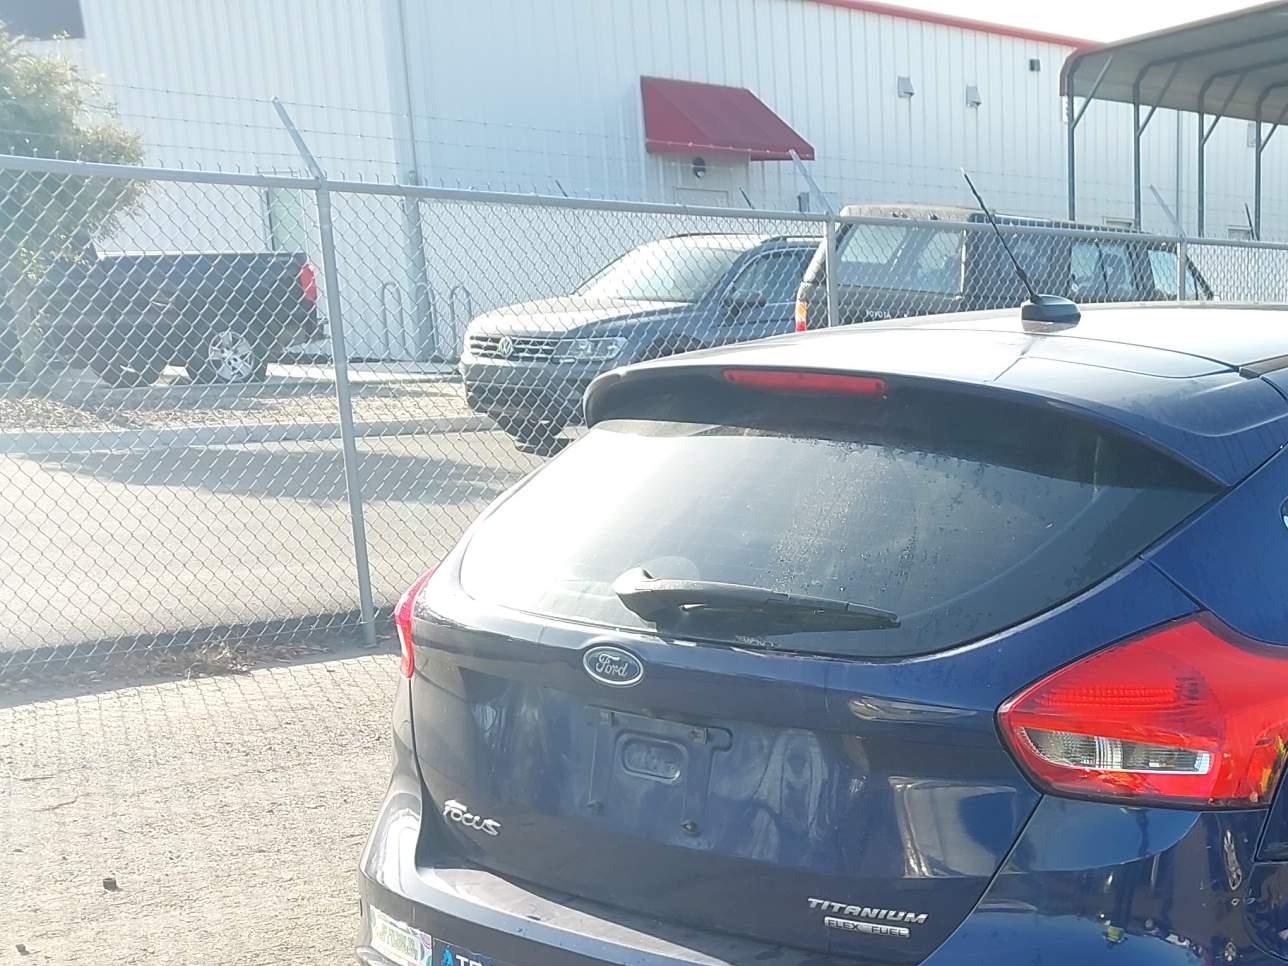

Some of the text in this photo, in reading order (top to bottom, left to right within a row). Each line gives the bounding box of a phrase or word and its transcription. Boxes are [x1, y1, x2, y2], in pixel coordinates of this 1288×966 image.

[595, 653, 629, 677] Ford
[807, 897, 929, 924] TITANIUM
[827, 919, 909, 938] FLEX FUEL
